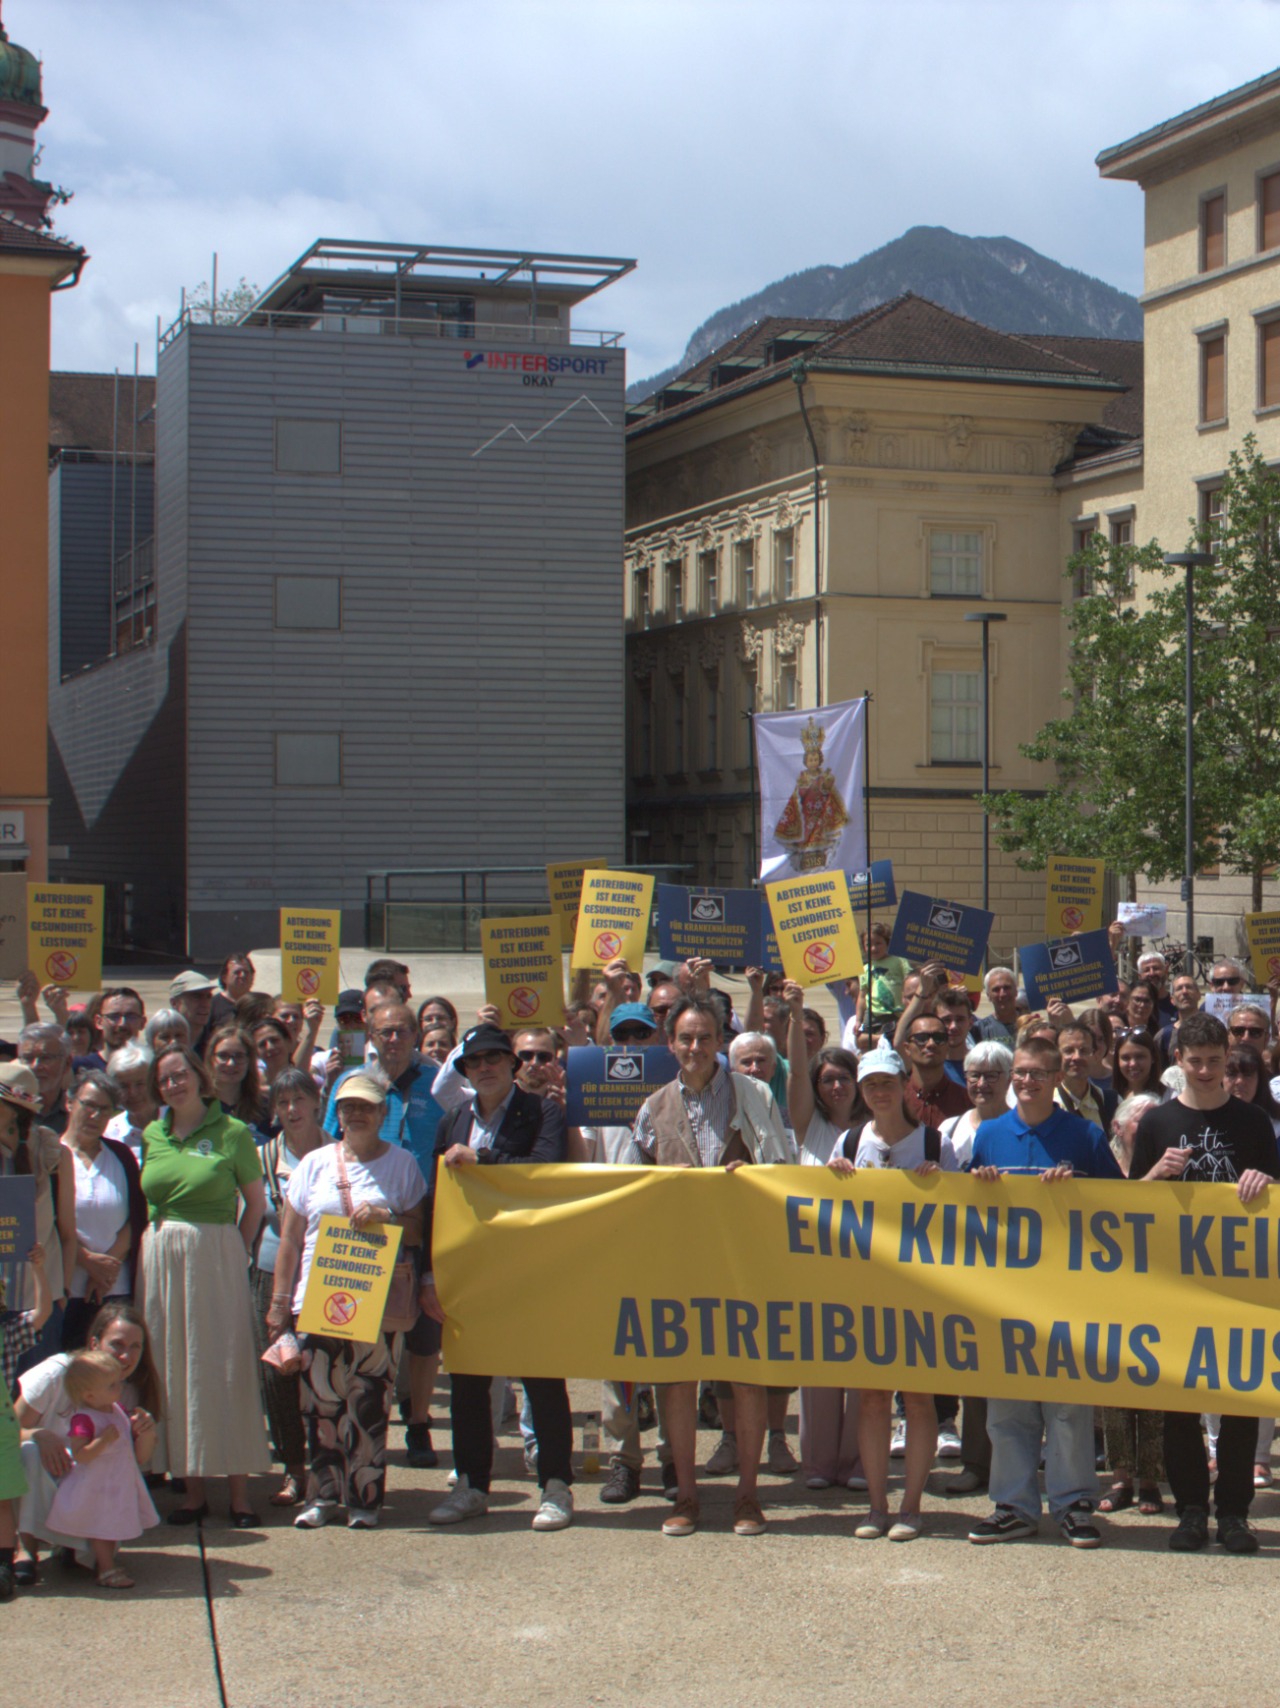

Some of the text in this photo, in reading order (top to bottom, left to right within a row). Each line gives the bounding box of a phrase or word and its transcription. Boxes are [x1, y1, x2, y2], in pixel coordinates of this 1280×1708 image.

[487, 352, 608, 374] INTERSPORT
[522, 375, 556, 387] OKAY
[590, 879, 643, 892] ABTREIBUNG
[776, 880, 836, 901] ABTREIBUNG
[34, 893, 93, 905] ABTREIBUNG
[596, 892, 636, 904] IST KEINE
[584, 904, 644, 918] GESUNDHEITS-
[788, 896, 832, 914] IST KEINE
[43, 908, 86, 919] IST KEINE
[779, 909, 847, 931] GESUNDHEITS-
[591, 919, 633, 931] LEISTUNG!
[669, 920, 683, 930] FÜR
[490, 926, 550, 940] ABTREIBUNG
[671, 933, 682, 942] DIE
[684, 935, 705, 945] LEBEN
[792, 924, 840, 944] LEISTUNG!
[500, 941, 545, 954] IST KEINE
[676, 946, 695, 956] NICHT
[489, 955, 557, 968] GESUNDHEITS-
[500, 971, 548, 985] LEISTUNG!
[582, 1082, 597, 1093] FÜR
[583, 1097, 596, 1106] DIE
[599, 1097, 622, 1106] LEBEN
[588, 1110, 612, 1119] NICHT
[326, 1226, 388, 1247] ABTREIBUNG
[786, 1195, 874, 1261] EIN
[898, 1201, 1043, 1269] KIND
[1068, 1209, 1155, 1273] IST
[332, 1243, 379, 1260] IST KEINE
[317, 1256, 386, 1277] GESUNDHEITS-
[323, 1275, 373, 1292] LEISTUNG!
[613, 1297, 979, 1373] ABTREIBUNG
[999, 1318, 1161, 1387] RAUS
